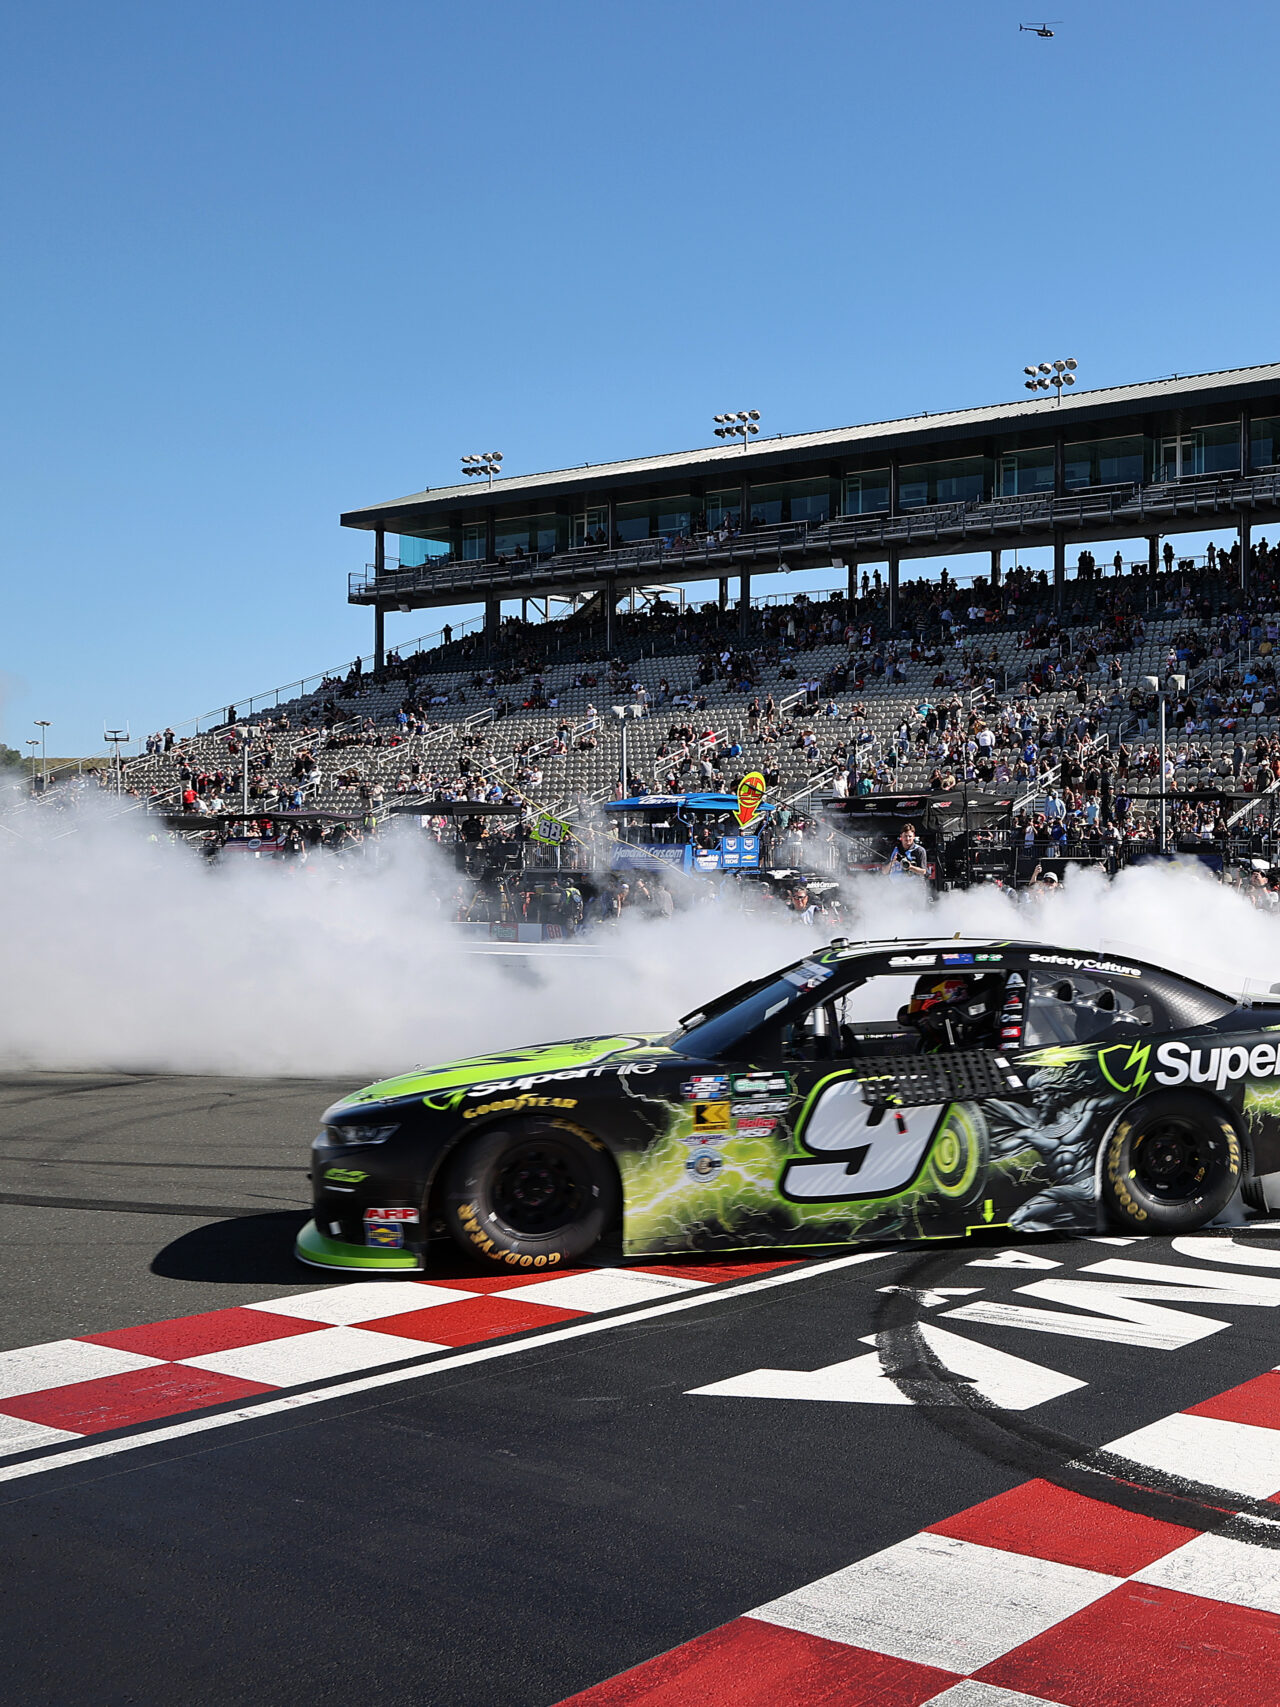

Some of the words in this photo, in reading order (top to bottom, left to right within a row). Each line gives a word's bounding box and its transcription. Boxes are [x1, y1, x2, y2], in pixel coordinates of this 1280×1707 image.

[1028, 954, 1142, 976] SafetyCulture
[467, 1061, 658, 1098] SuperFile
[462, 1092, 579, 1119] GOODYEAR
[783, 1075, 947, 1199] 9
[1220, 1122, 1240, 1176] EAGLE
[366, 1208, 418, 1219] ARP
[457, 1203, 561, 1267] GOODYEAR
